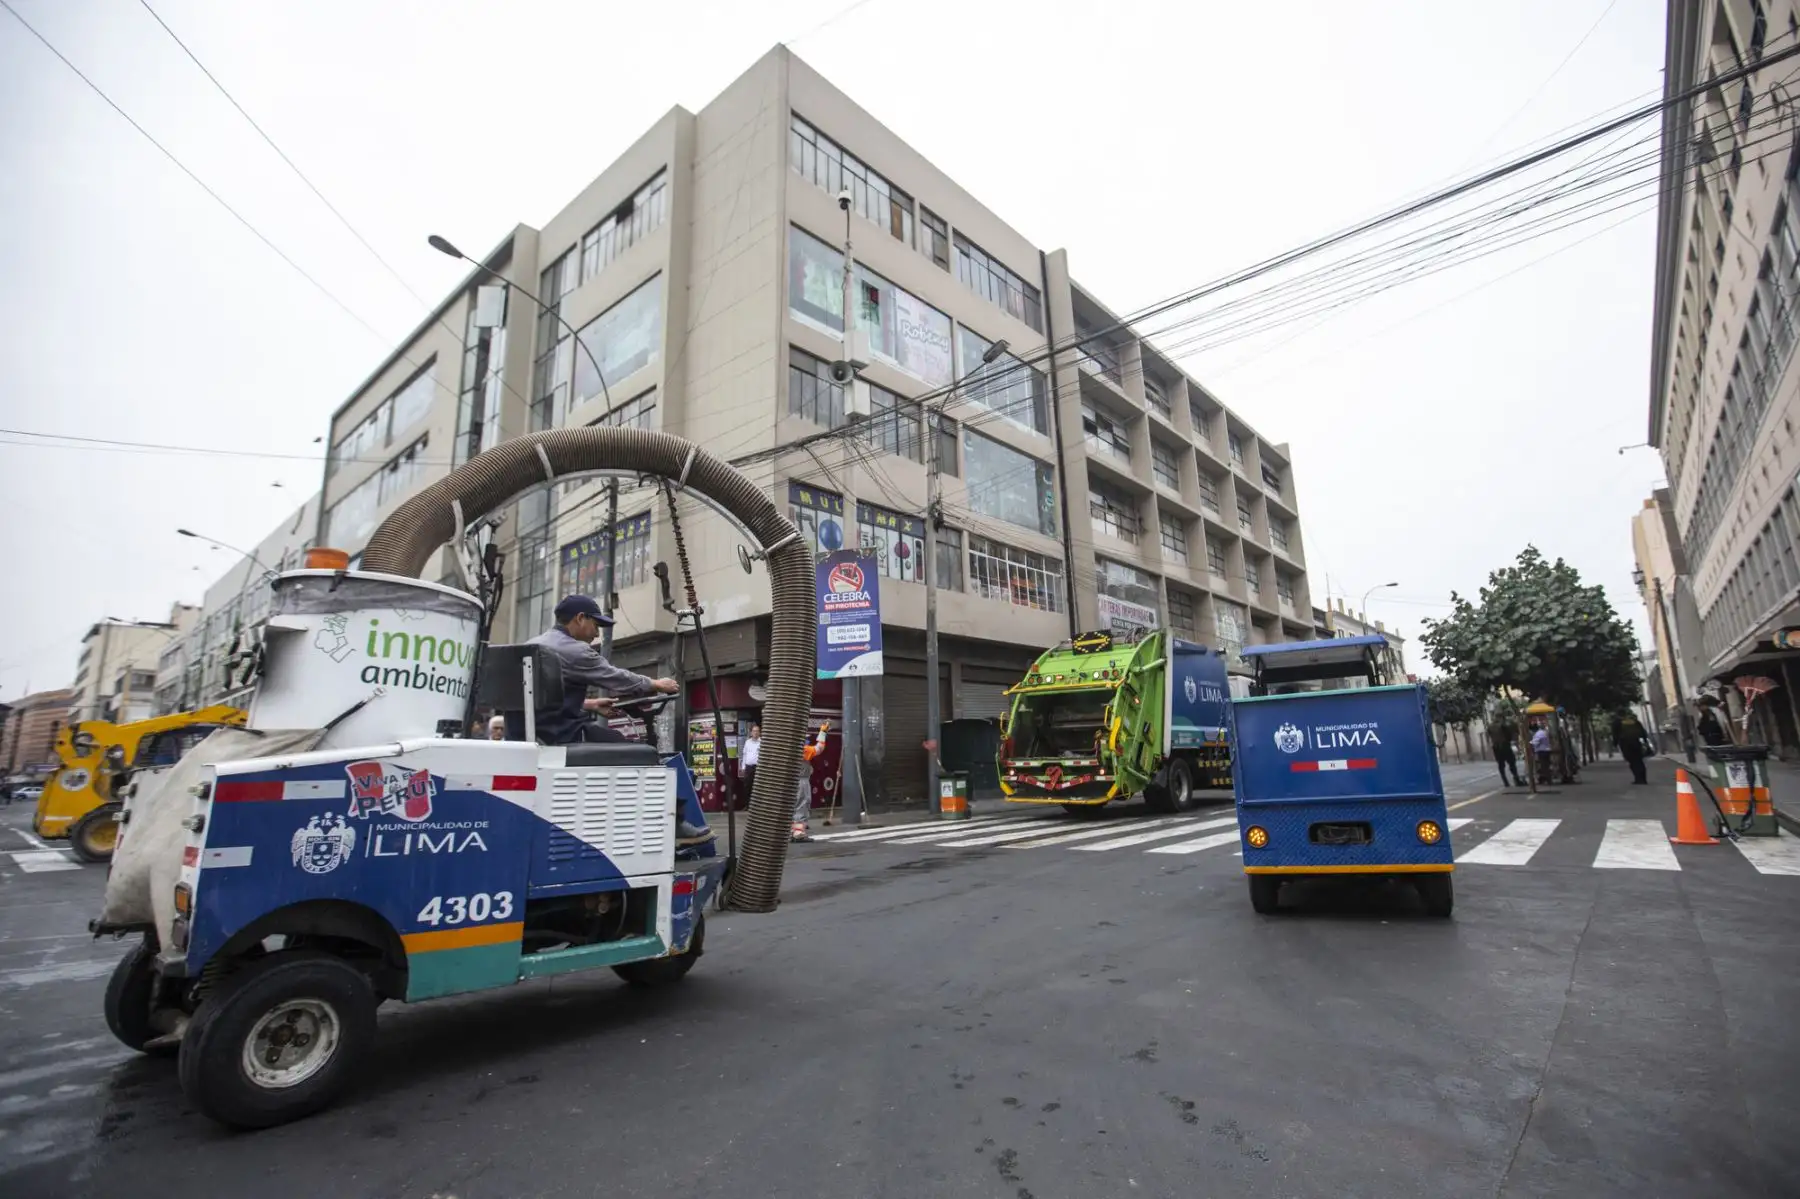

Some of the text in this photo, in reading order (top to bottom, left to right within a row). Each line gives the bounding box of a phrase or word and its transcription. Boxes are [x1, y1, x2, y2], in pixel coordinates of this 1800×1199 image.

[823, 590, 871, 604] CELEBRA
[1200, 687, 1223, 703] LIMA
[1315, 723, 1368, 732] MUNICIPALIDAD
[1316, 729, 1382, 749] LIMA
[376, 821, 490, 831] MUNICIPALIDAD DE
[374, 831, 488, 857] LIMA
[416, 891, 513, 926] 4303
